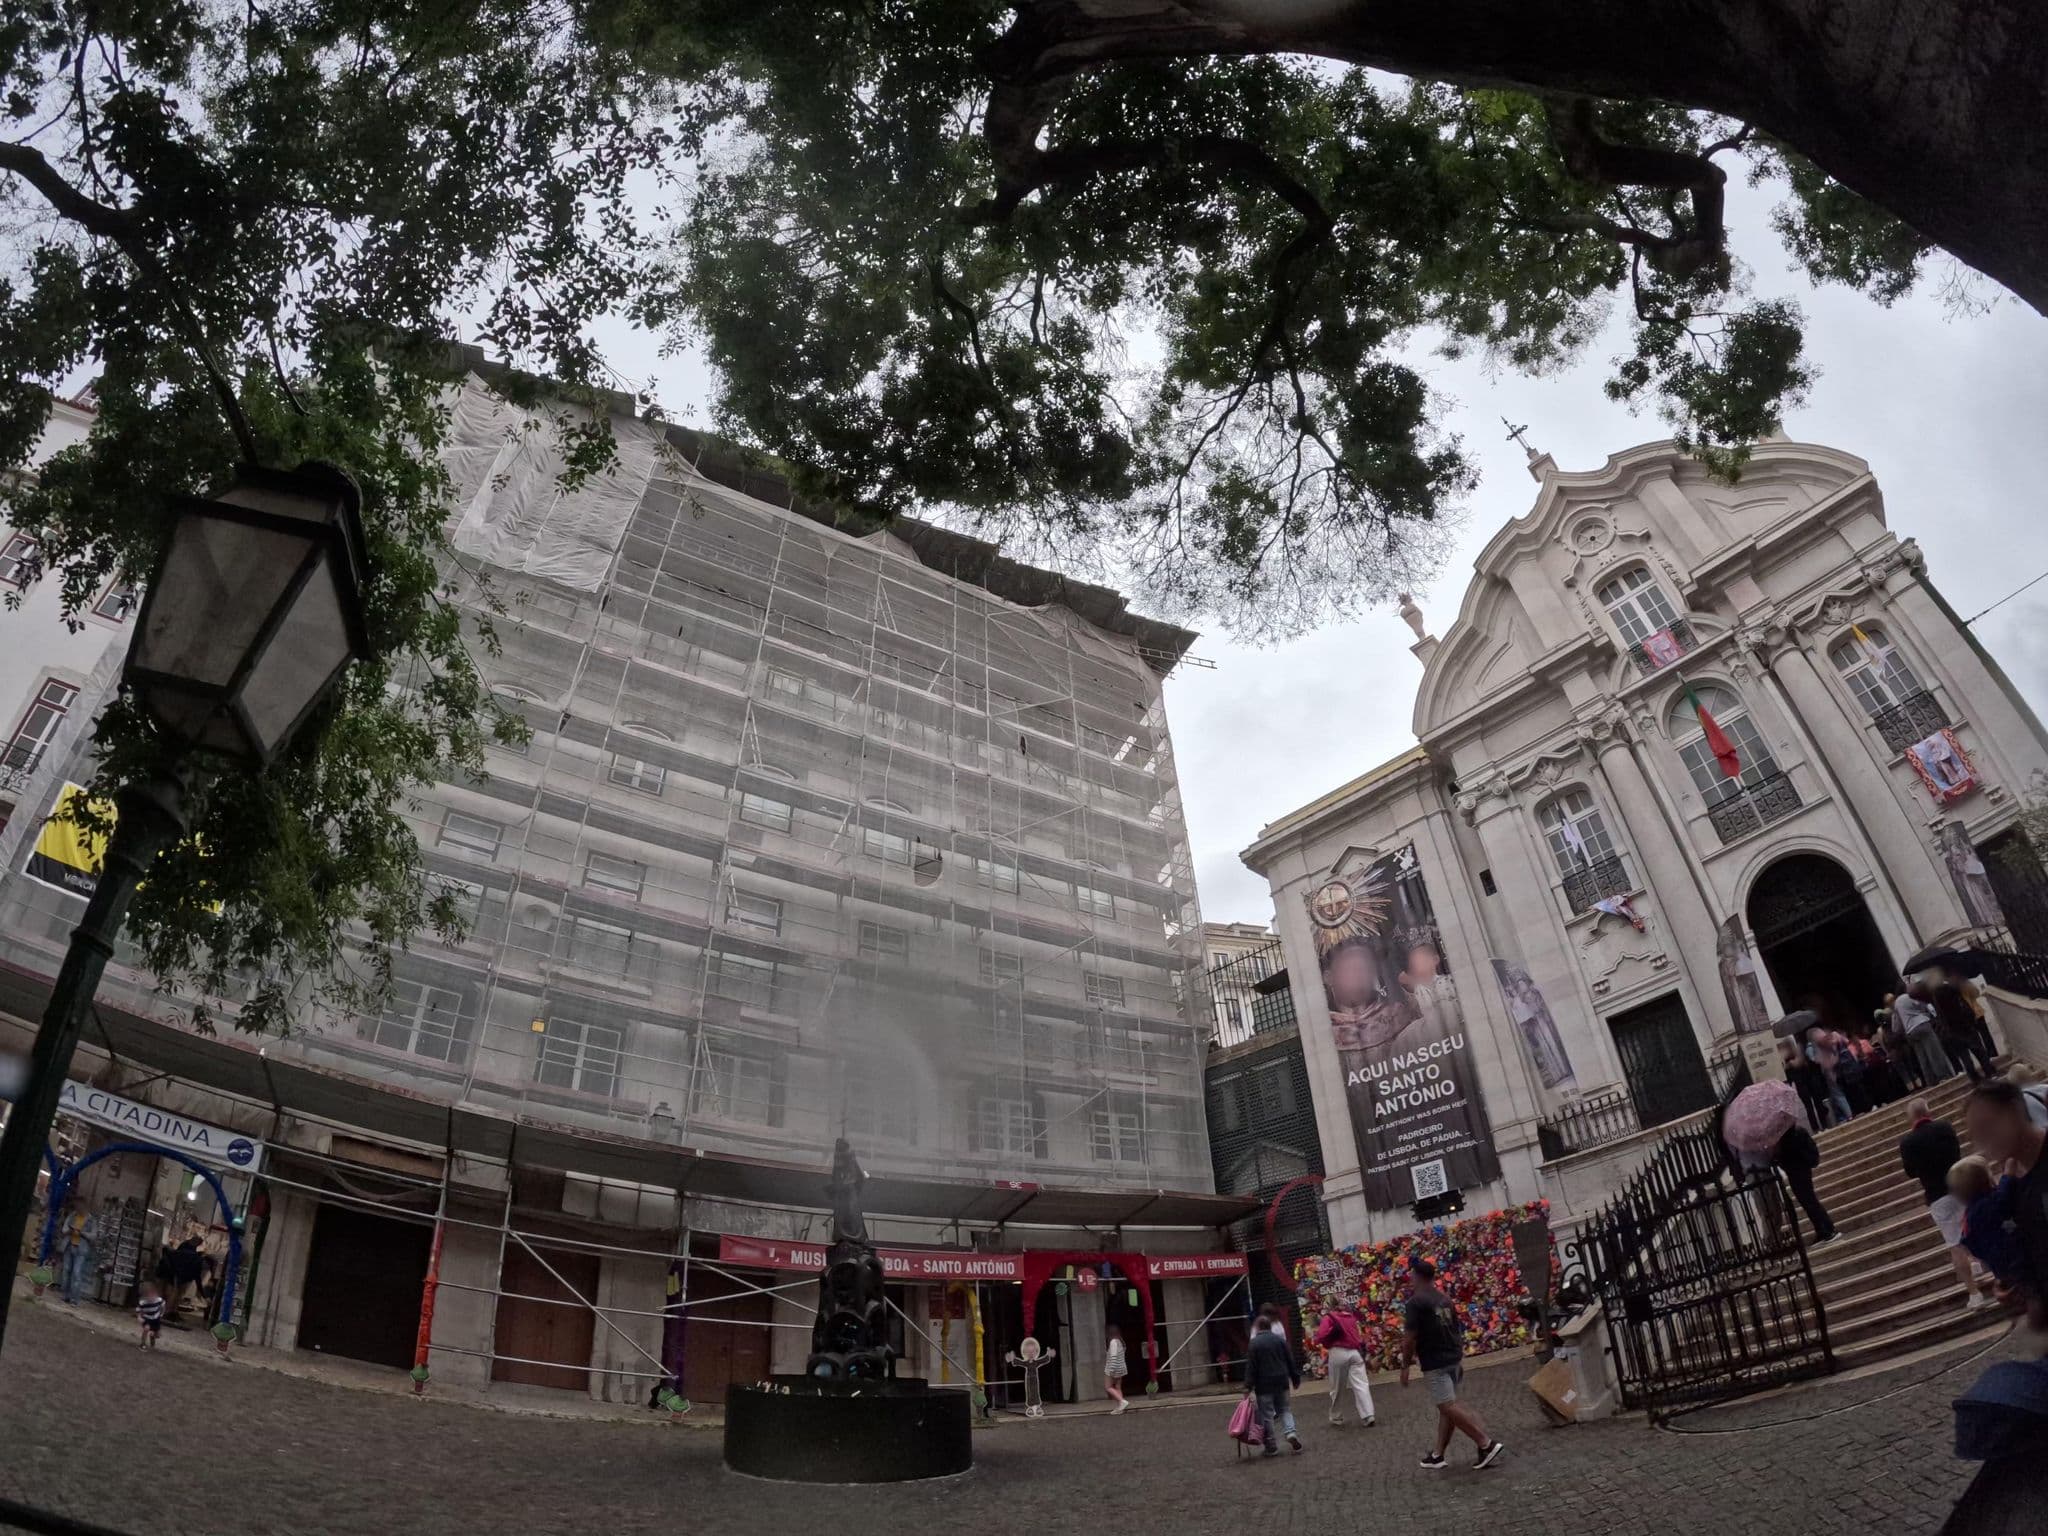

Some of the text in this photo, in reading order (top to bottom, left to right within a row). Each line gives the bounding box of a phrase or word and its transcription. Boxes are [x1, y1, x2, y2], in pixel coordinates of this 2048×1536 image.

[1348, 1033, 1464, 1086] AQUI NASCEU
[1378, 1063, 1440, 1096] SANTO
[1375, 1079, 1455, 1118] ANTÓNIO
[88, 1092, 210, 1147] CITADINA
[1385, 1115, 1415, 1130] ANTHONY
[1416, 1110, 1432, 1119] WAS
[1432, 1105, 1450, 1115] BORN
[1398, 1123, 1444, 1142] PADROEIRO
[1377, 1151, 1387, 1160] DE
[1420, 1139, 1432, 1148] DE
[1391, 1158, 1409, 1168] SAINT
[1446, 1145, 1454, 1153] OF
[790, 1249, 827, 1267] MUS
[879, 1257, 910, 1272] BOA
[923, 1260, 962, 1274] SANTO
[966, 1258, 1015, 1275] ANTÓNIO
[1164, 1259, 1198, 1271] ENTRADA
[1207, 1257, 1244, 1270] ENTRANCE
